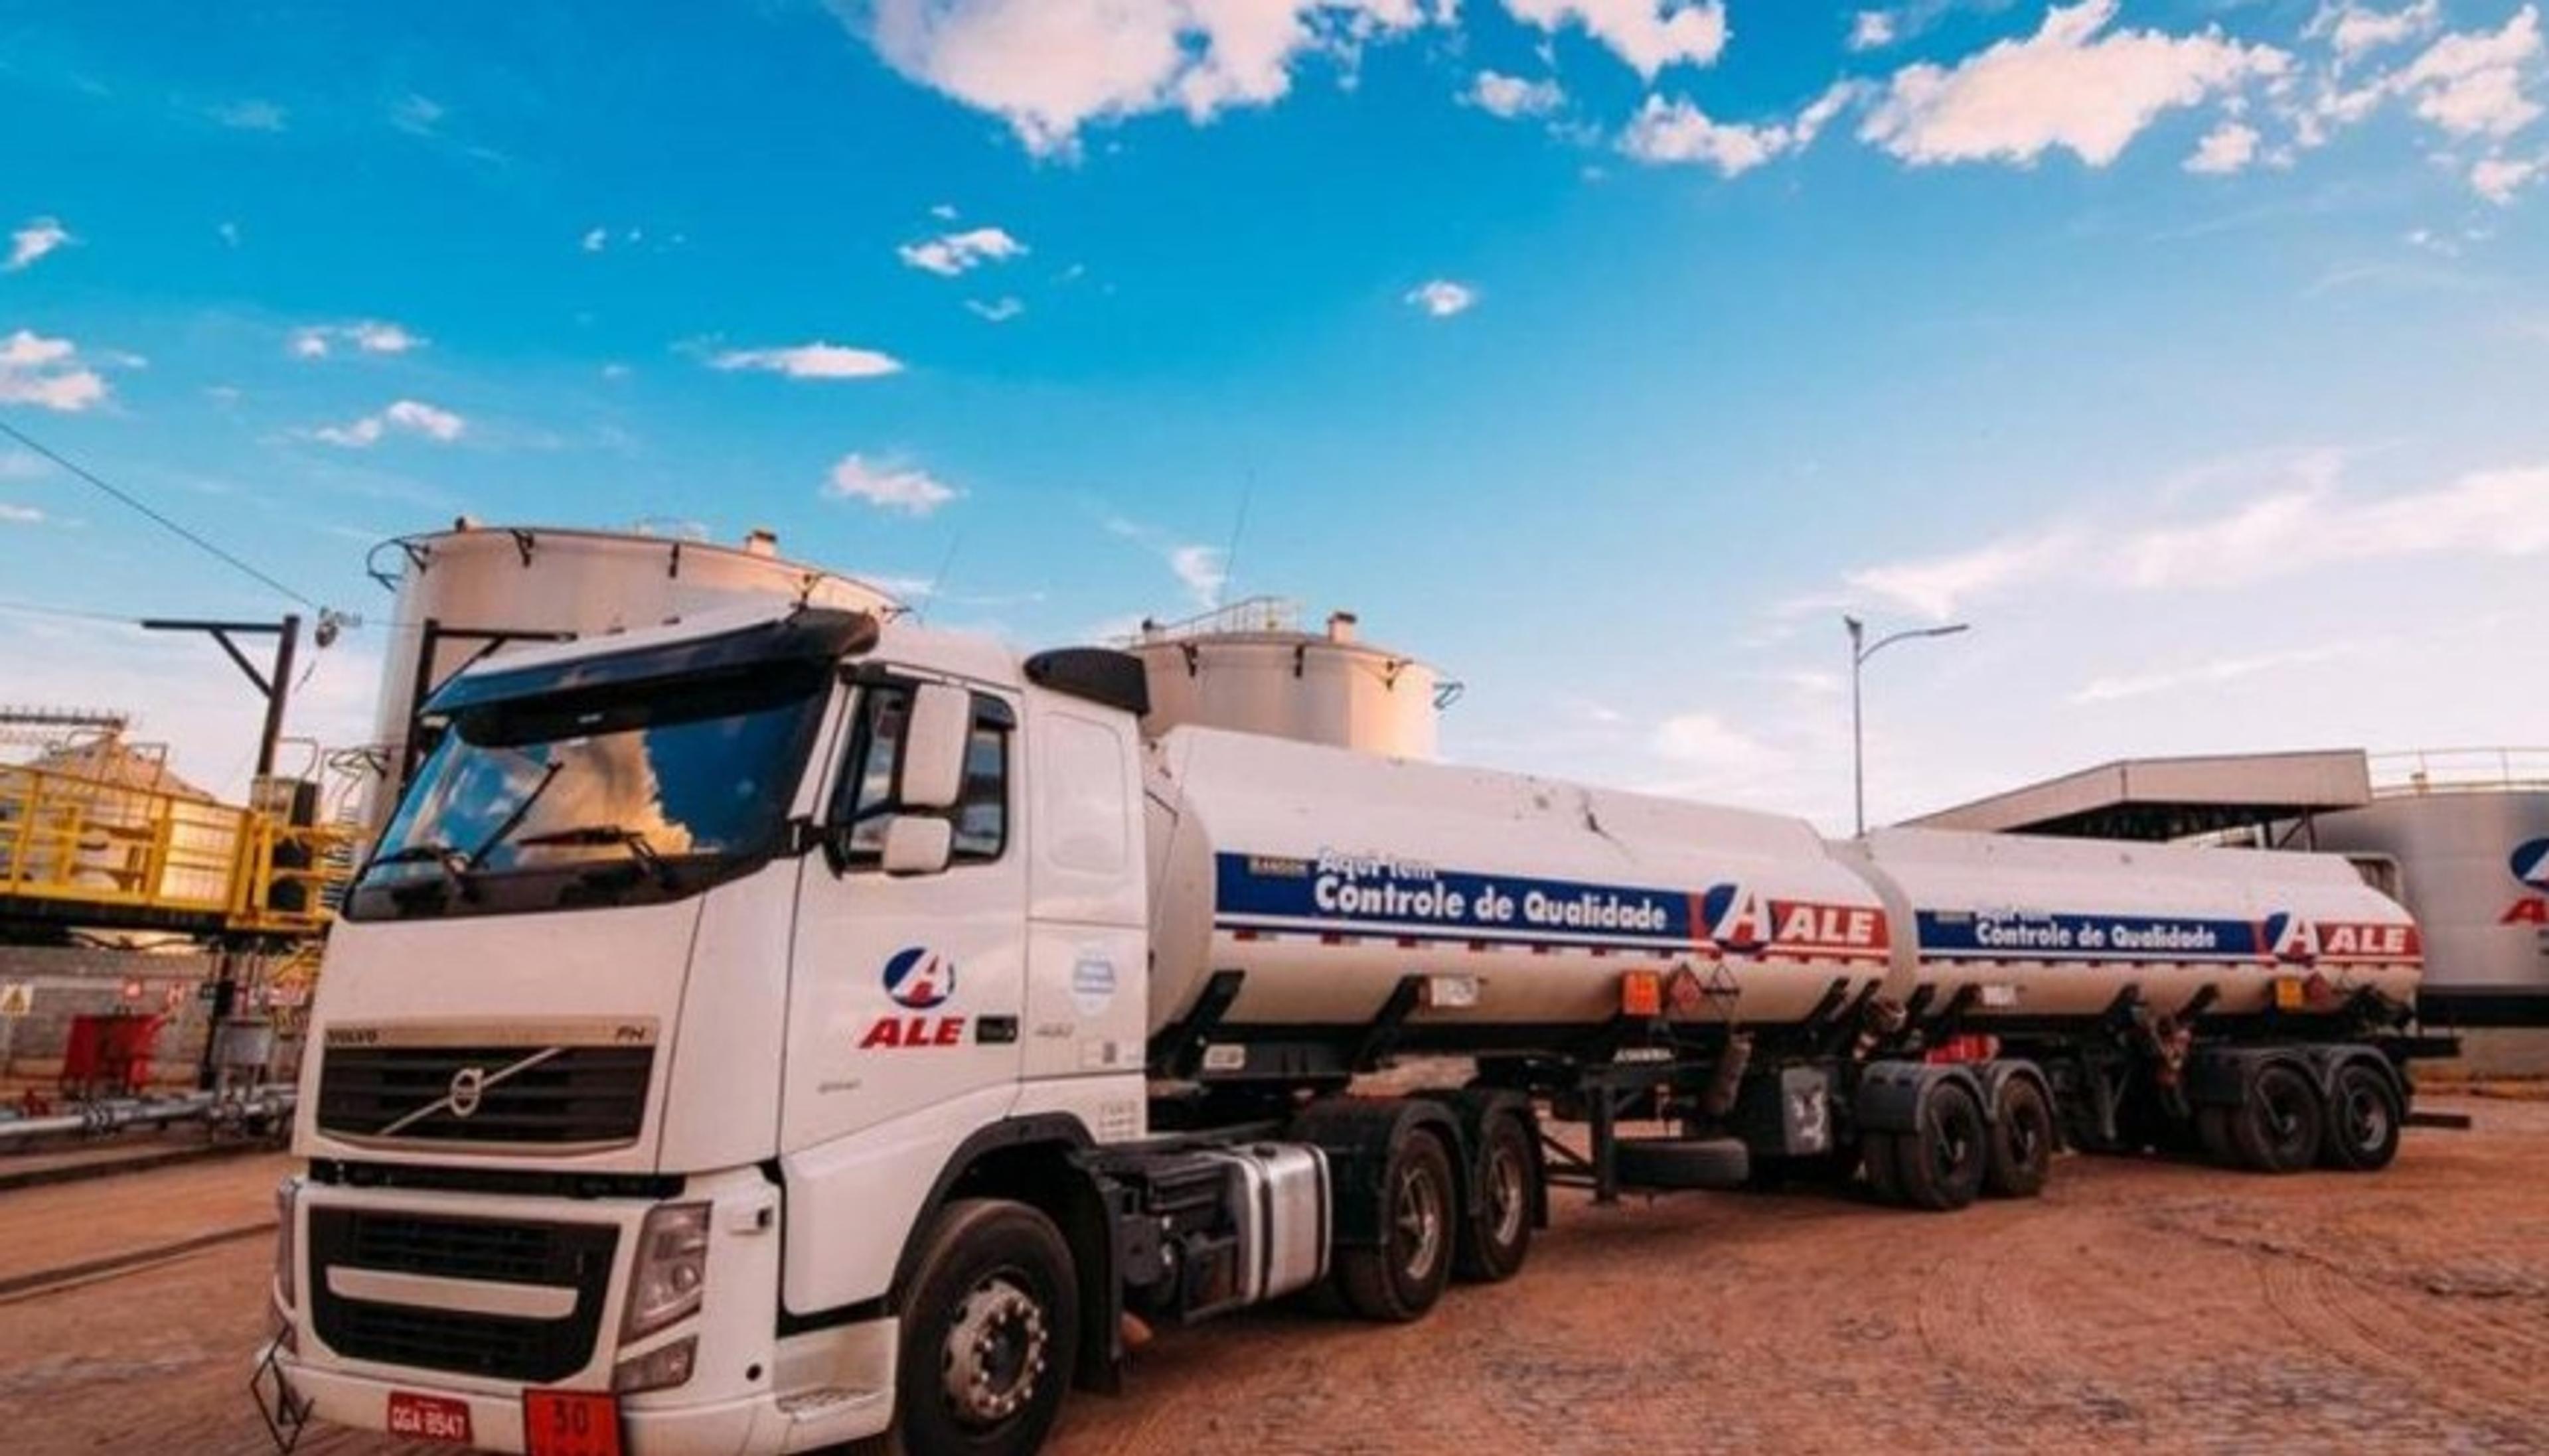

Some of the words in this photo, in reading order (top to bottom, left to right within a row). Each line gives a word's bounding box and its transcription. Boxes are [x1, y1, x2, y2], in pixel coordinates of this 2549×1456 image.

[1315, 875, 1464, 918] Controle
[1474, 885, 1513, 920] de
[1524, 891, 1667, 929] Qualidade
[1779, 907, 1875, 944] ALE
[1976, 920, 2072, 947] Controle
[2077, 922, 2105, 948] de
[2112, 924, 2216, 949] Qualidade
[2325, 926, 2406, 954] ALE
[859, 1018, 965, 1049] ALE
